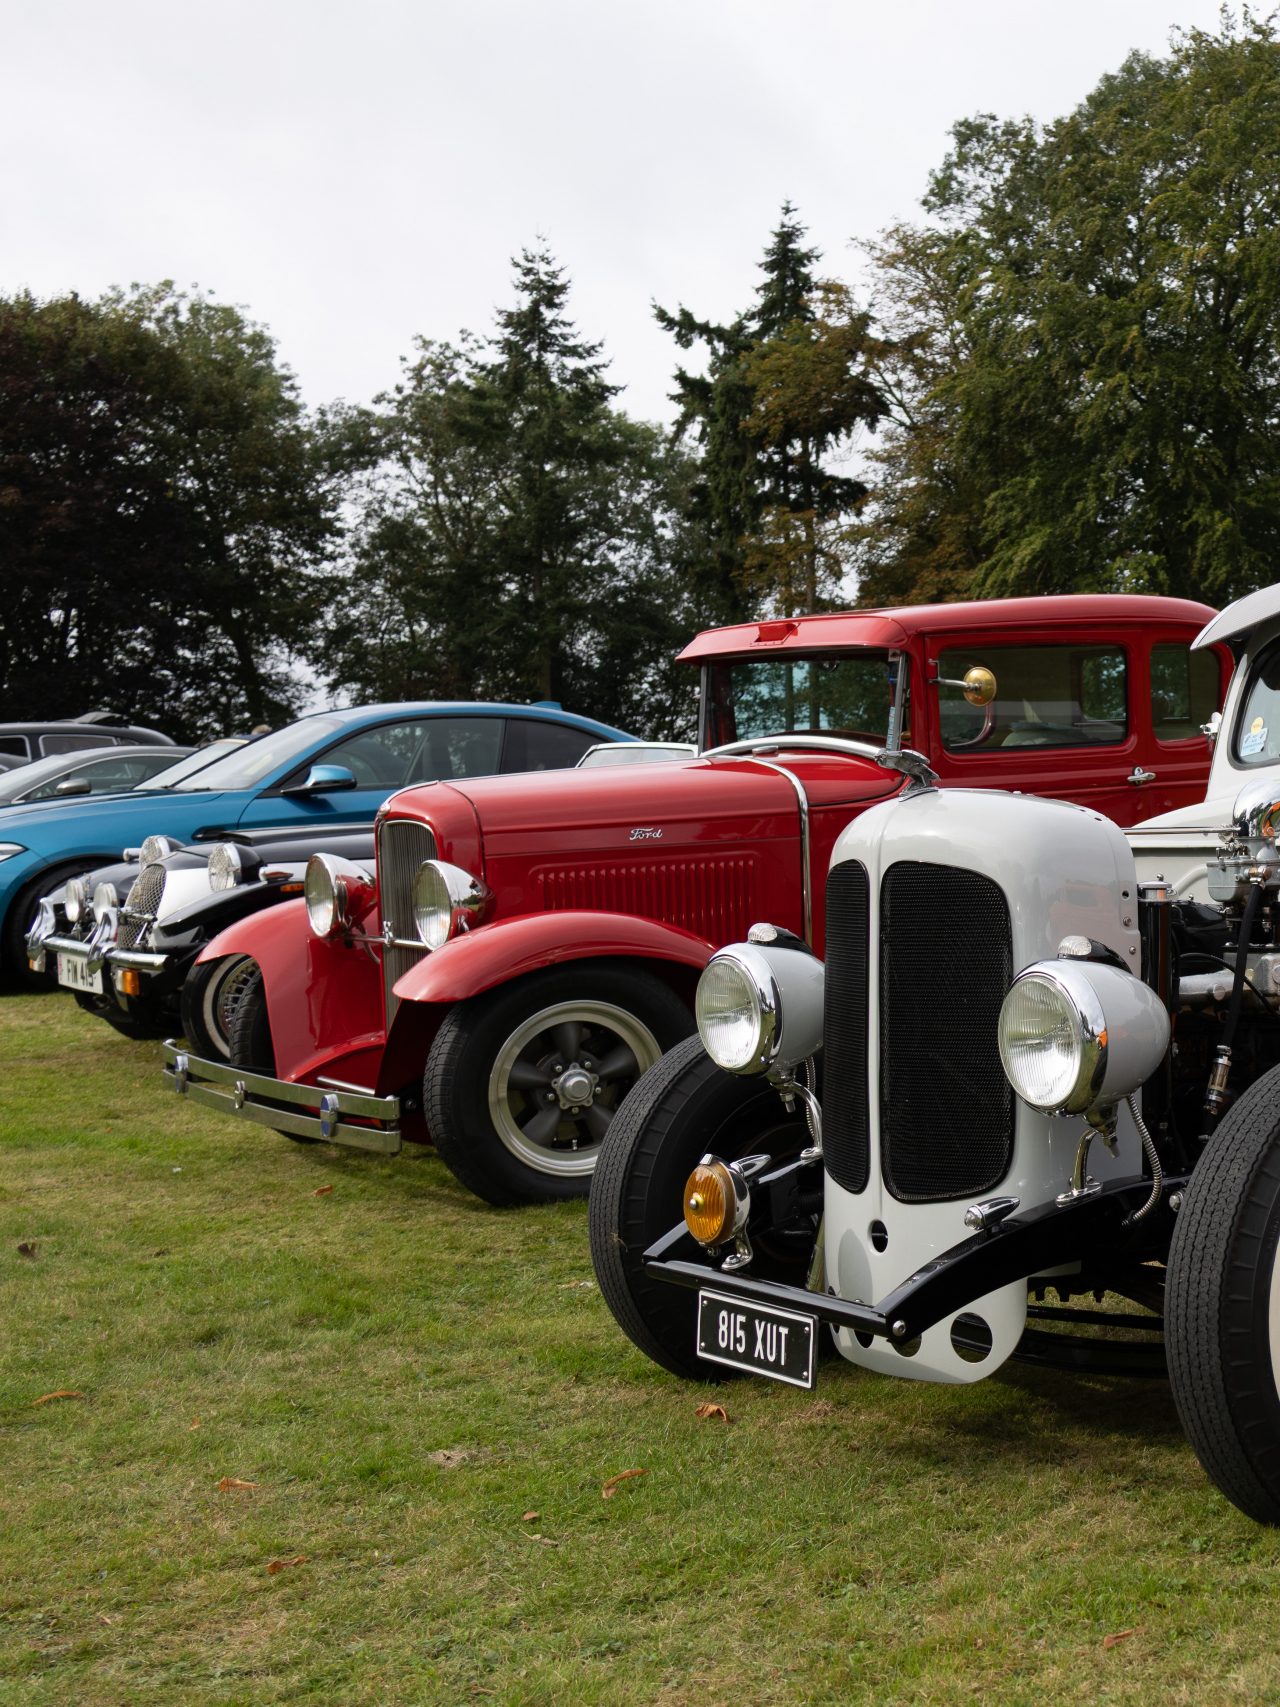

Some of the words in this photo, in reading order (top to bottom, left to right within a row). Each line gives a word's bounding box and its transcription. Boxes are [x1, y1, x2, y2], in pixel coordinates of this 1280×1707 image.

[629, 827, 663, 841] Ford
[718, 1309, 747, 1354] 815
[754, 1319, 790, 1366] XUT
